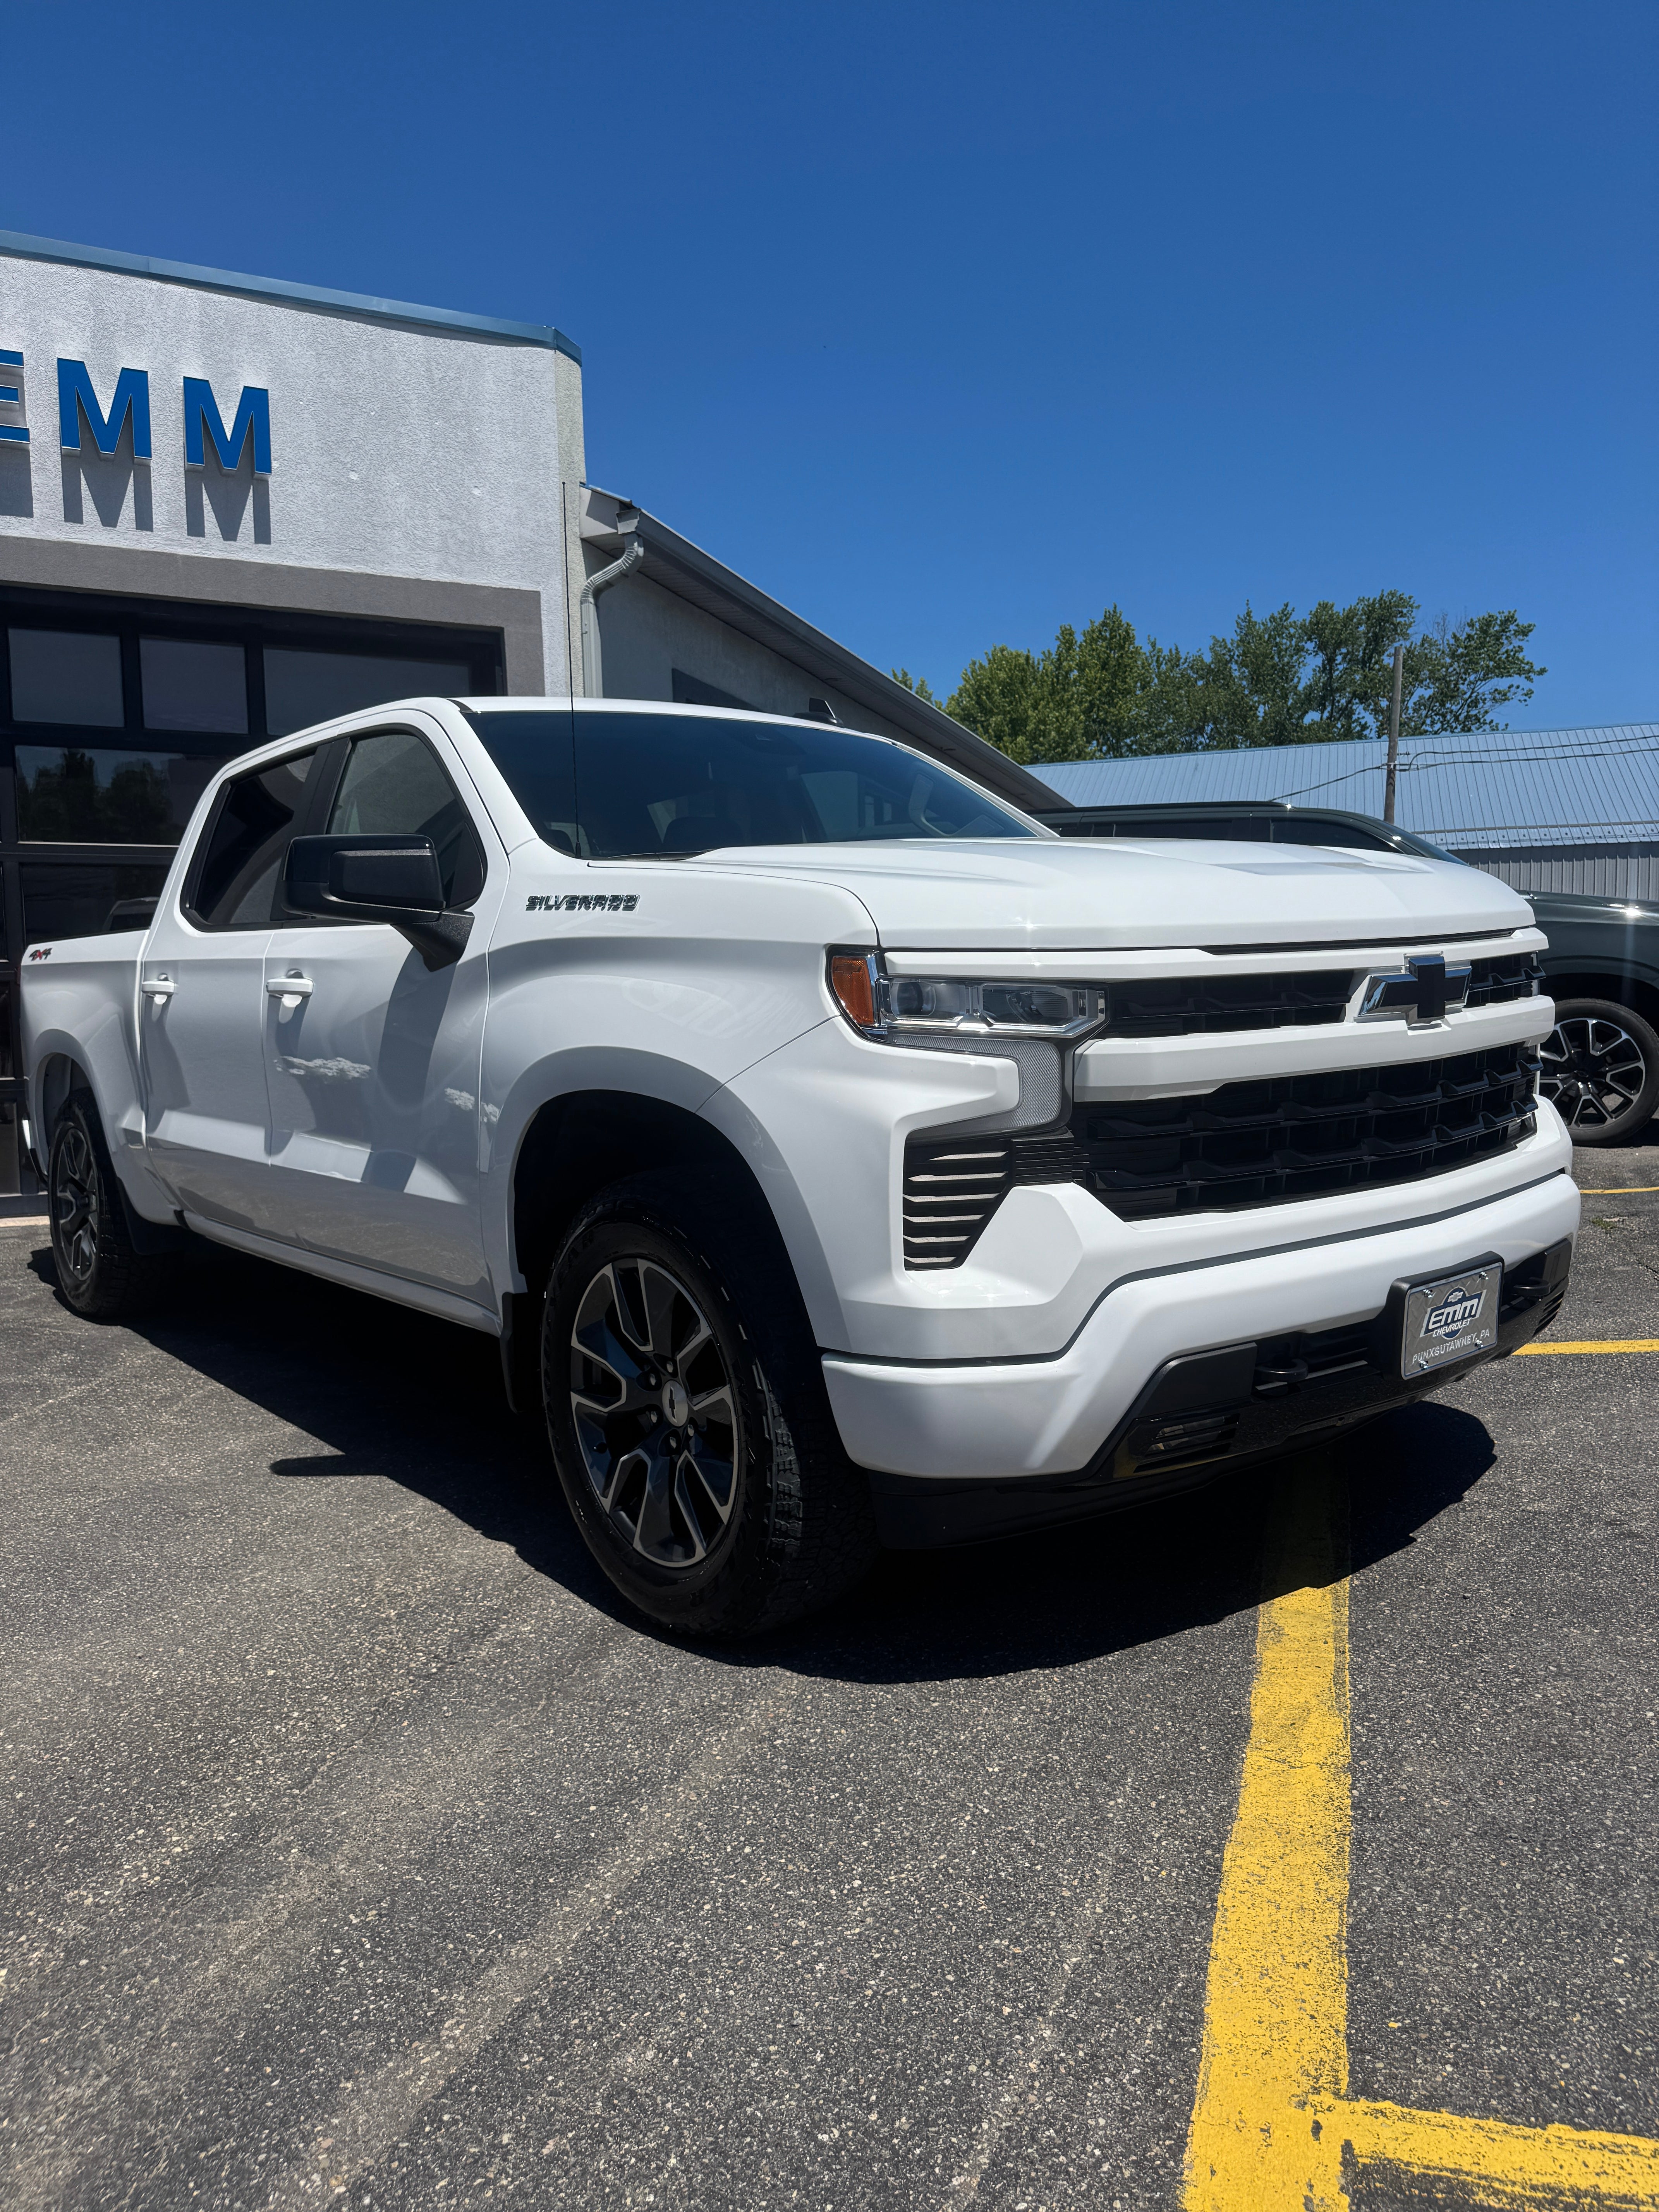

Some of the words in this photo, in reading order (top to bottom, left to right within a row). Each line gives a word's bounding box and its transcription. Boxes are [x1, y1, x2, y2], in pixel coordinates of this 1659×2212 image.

[526, 895, 640, 908] SILVERADO
[1433, 1318, 1471, 1337] CHEVROLET
[1480, 1328, 1490, 1338] PA
